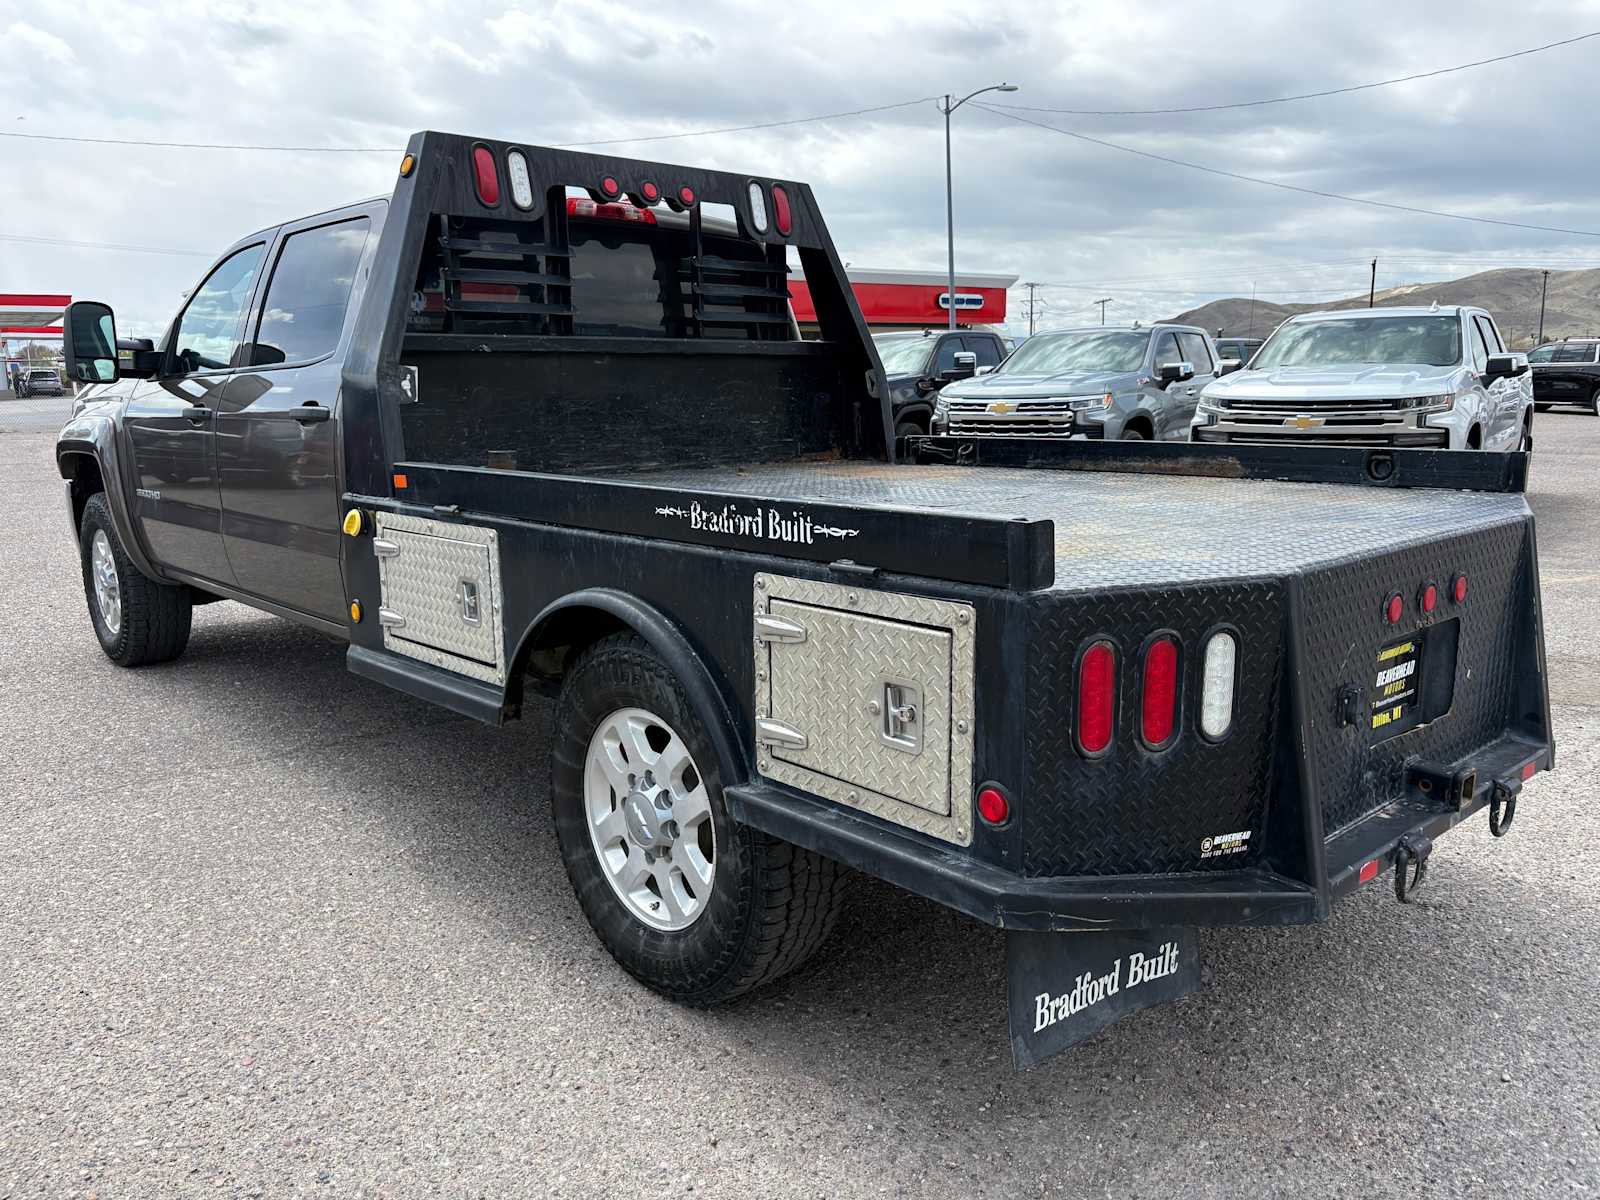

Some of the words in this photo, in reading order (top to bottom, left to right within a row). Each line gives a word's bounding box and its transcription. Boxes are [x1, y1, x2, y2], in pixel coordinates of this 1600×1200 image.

[690, 500, 763, 538] Bradford
[768, 508, 813, 544] Built
[1376, 660, 1415, 688] BEAVERHEAD
[1383, 678, 1406, 697] MOTORS
[1393, 705, 1402, 721] MT
[1213, 831, 1251, 845] BEAVERHEAD
[1033, 958, 1121, 1033] Bradford
[1126, 942, 1179, 989] Built
